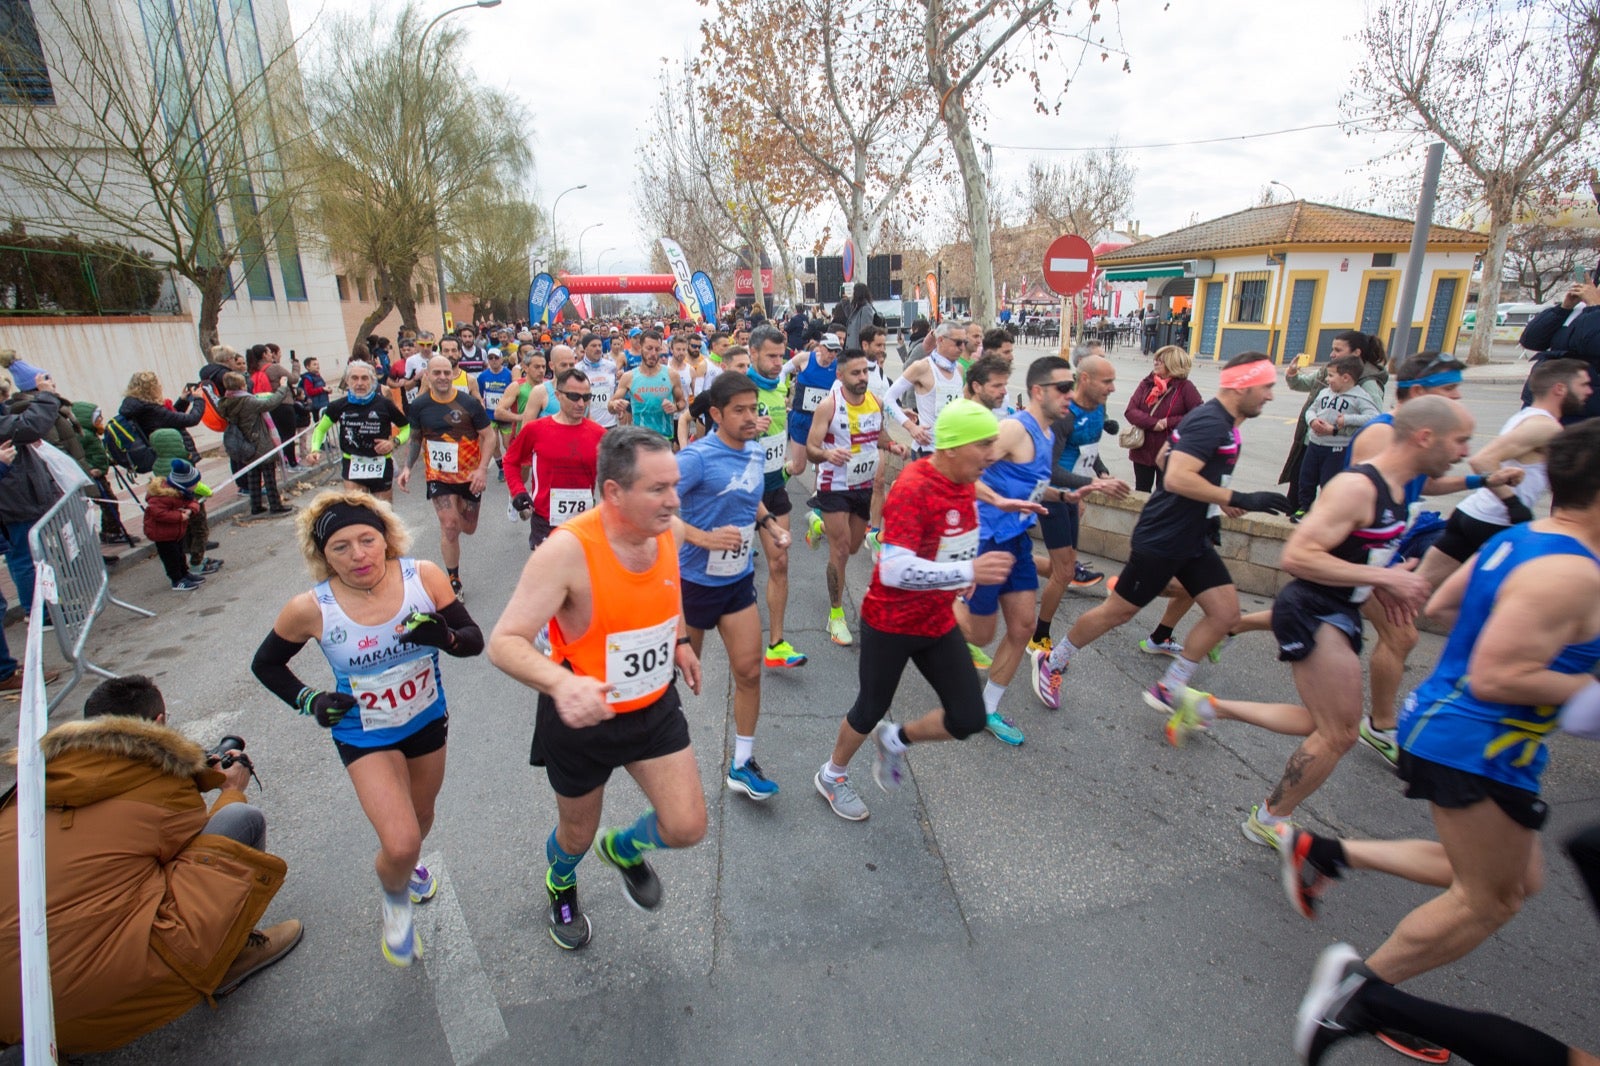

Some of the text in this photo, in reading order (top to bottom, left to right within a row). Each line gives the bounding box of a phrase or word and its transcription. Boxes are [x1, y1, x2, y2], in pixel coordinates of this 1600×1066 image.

[591, 393, 607, 402] 710
[1321, 396, 1349, 413] GAP
[432, 450, 452, 463] 236
[766, 444, 784, 461] 613
[352, 463, 383, 473] 3165
[853, 461, 875, 475] 407
[558, 501, 586, 514] 578
[624, 642, 669, 678] 303
[360, 668, 431, 711] 2107
